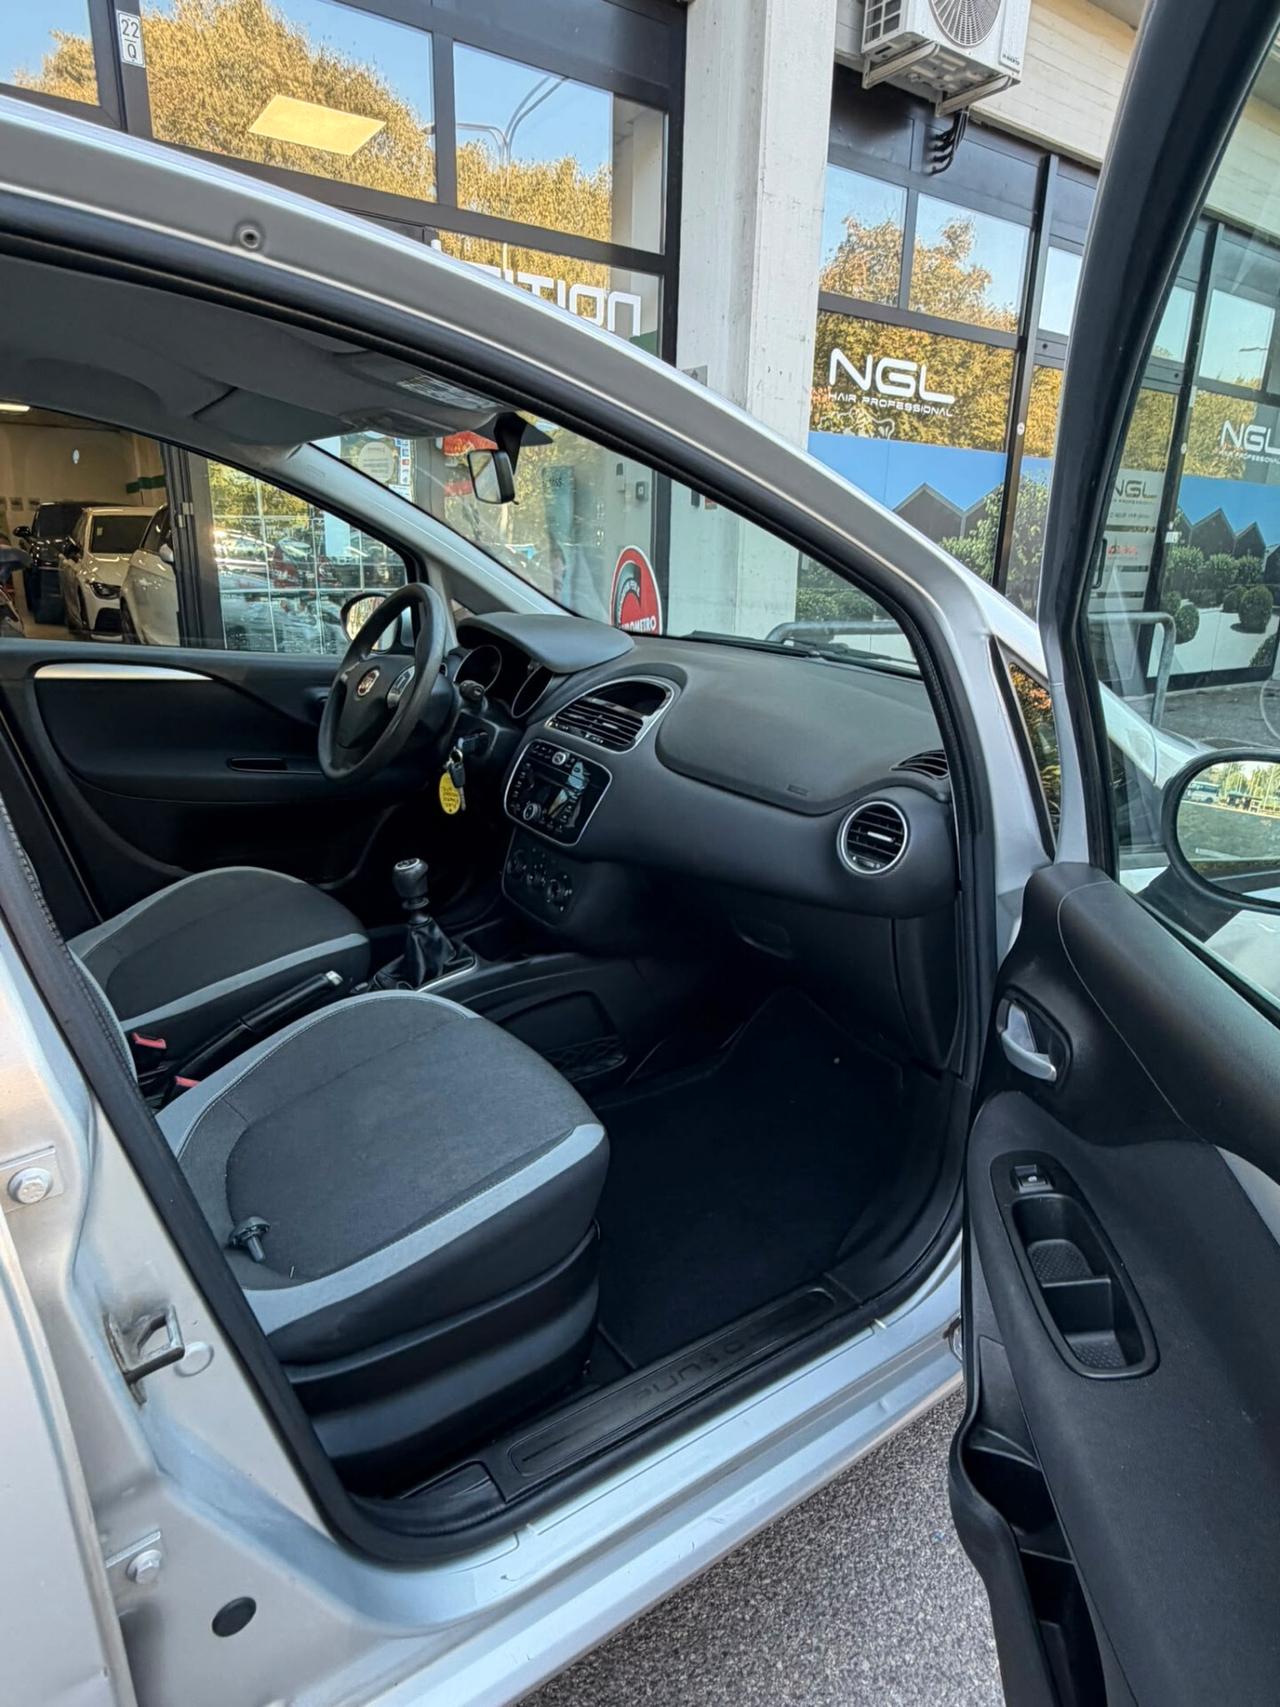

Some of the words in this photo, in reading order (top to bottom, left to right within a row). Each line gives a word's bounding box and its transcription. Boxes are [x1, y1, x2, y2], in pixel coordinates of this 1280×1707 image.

[121, 19, 139, 39] 22
[127, 43, 138, 60] Q
[828, 347, 956, 404] NGL
[828, 391, 857, 404] HAIR
[862, 396, 954, 417] PROFESSIONAL
[1220, 420, 1280, 455] NGL
